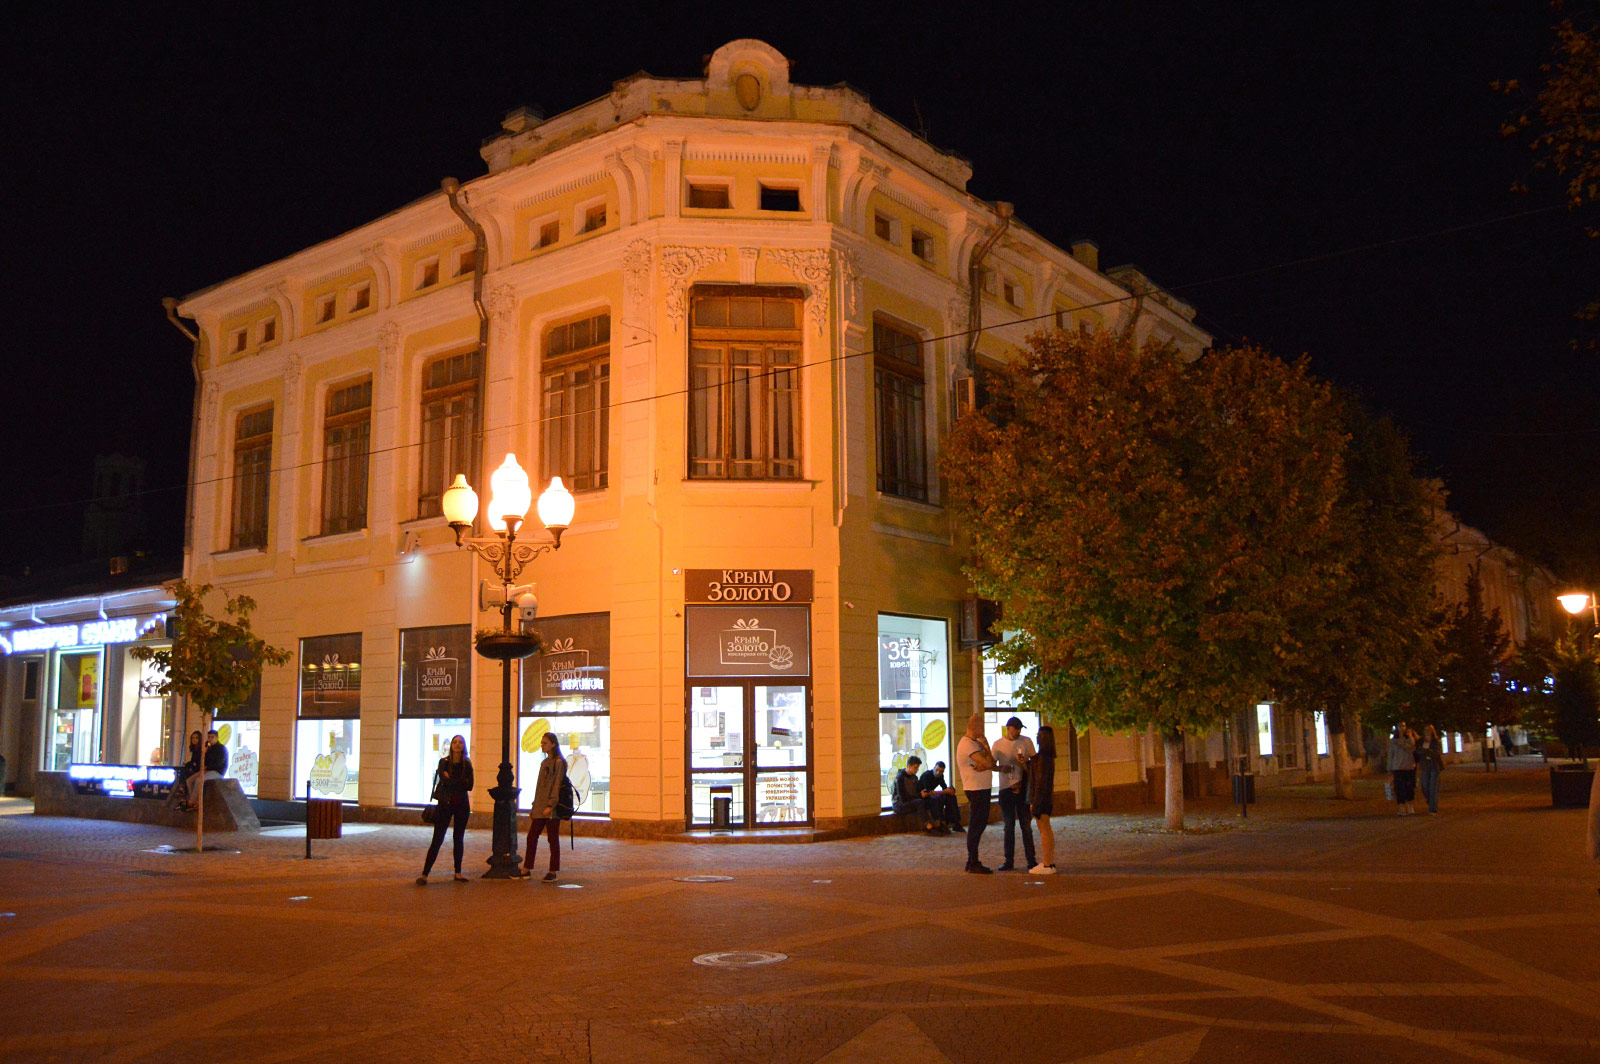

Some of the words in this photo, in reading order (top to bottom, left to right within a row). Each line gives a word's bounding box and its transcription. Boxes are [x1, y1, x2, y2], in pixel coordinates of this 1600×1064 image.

[722, 570, 774, 584] КРЫМ
[707, 581, 792, 601] ЗОЛОТО
[734, 636, 760, 644] КРЫМ
[727, 642, 769, 652] ЗОЛОТО
